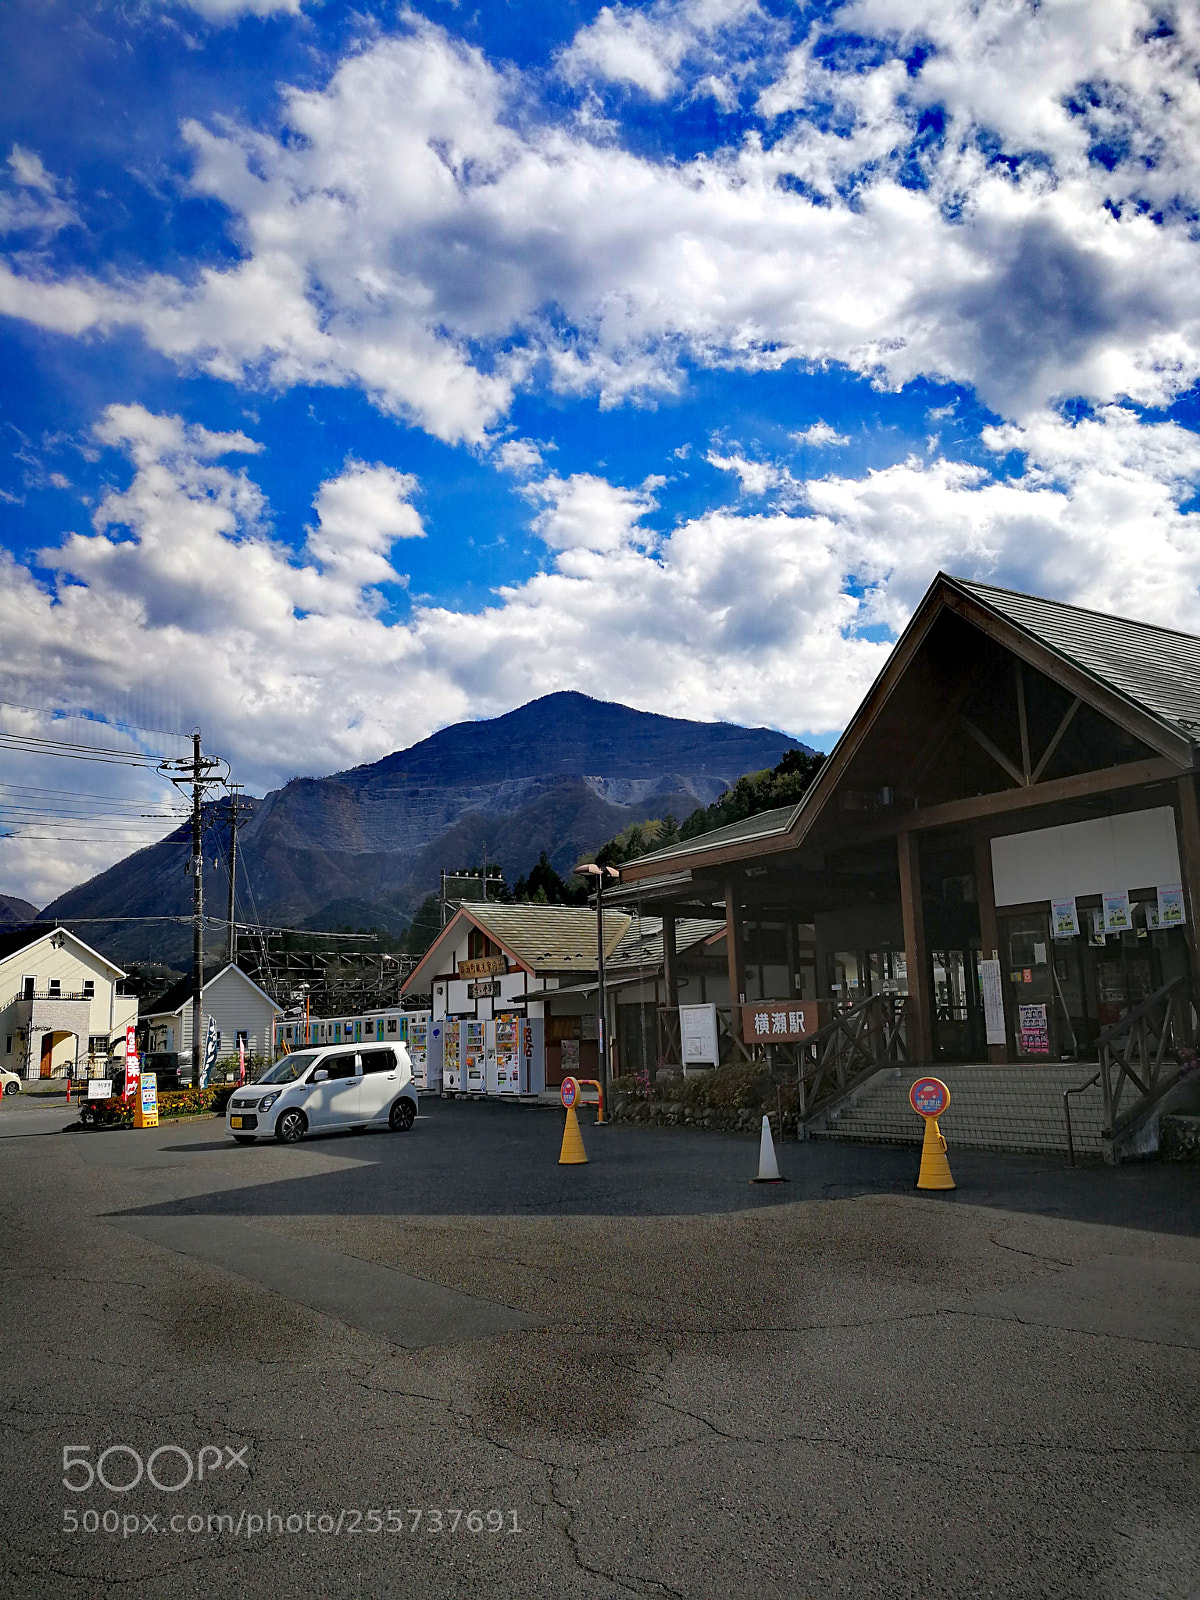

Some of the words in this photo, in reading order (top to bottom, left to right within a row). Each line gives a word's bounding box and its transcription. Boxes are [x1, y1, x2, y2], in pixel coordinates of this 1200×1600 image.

[754, 1011, 806, 1035] 横瀬駅
[526, 1027, 534, 1058] DyDo
[126, 1031, 140, 1097] 営業中
